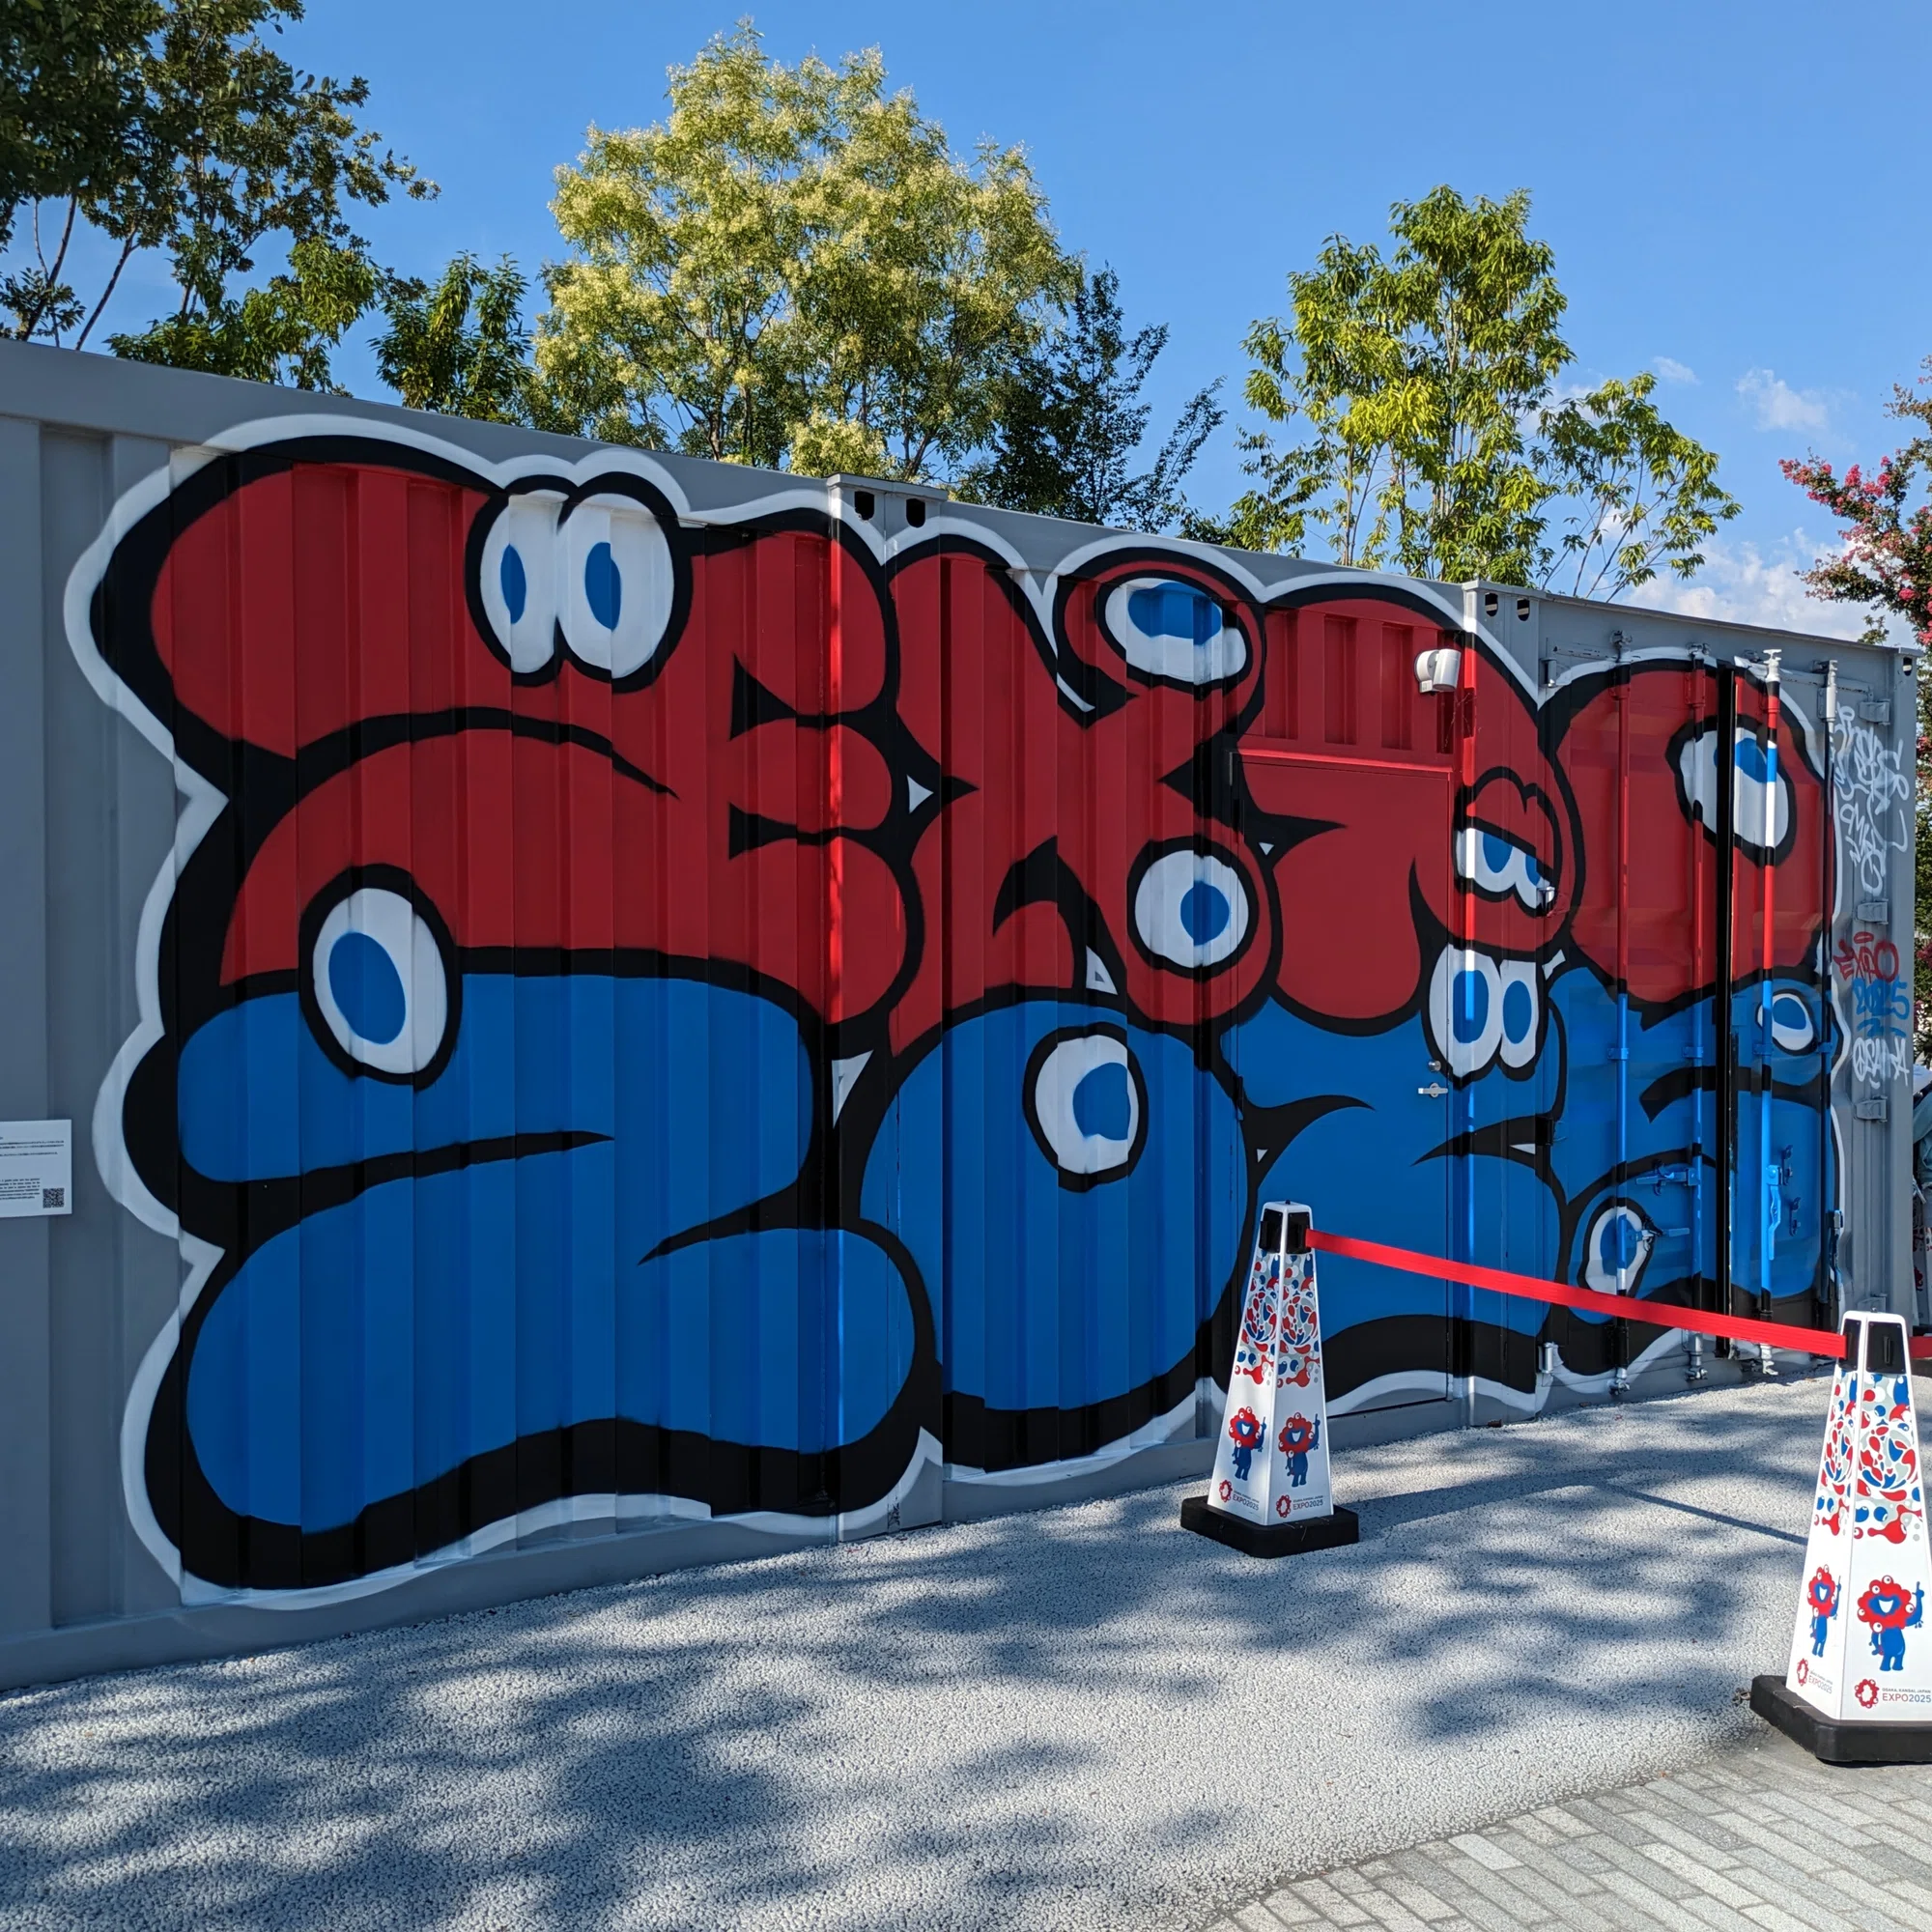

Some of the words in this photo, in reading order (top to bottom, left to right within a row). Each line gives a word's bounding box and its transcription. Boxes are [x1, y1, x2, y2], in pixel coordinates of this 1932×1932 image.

[1852, 976, 1911, 1020] 2025
[1293, 1499, 1323, 1510] EXPO2025
[1882, 1692, 1932, 1703] EXPO2025
